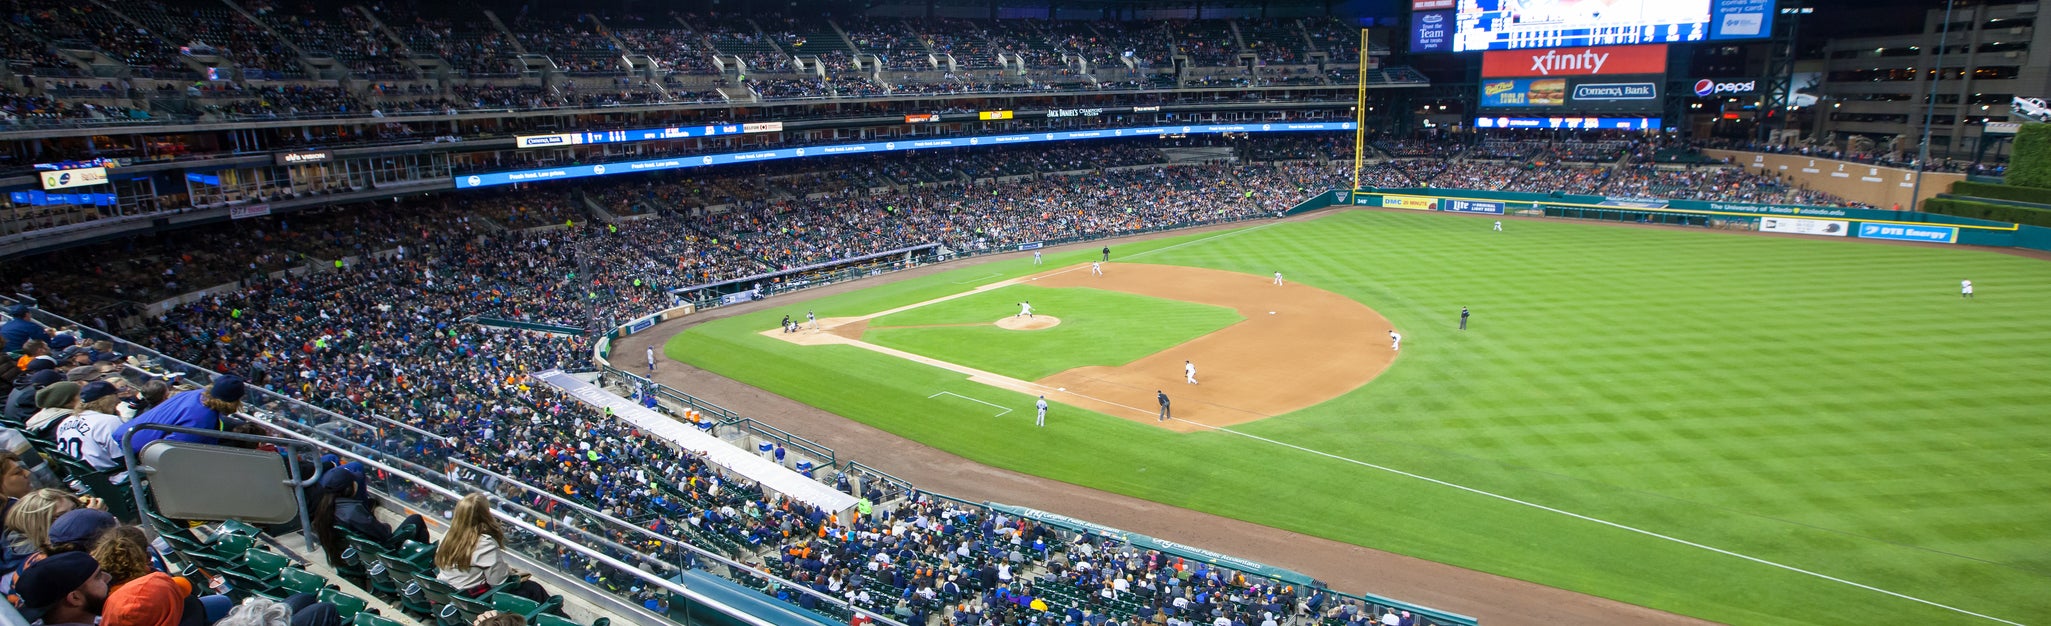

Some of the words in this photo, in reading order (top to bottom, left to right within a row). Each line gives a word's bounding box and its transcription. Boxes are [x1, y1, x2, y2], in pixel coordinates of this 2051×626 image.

[1420, 29, 1444, 38] Team
[1531, 49, 1610, 75] xfinity
[1625, 86, 1649, 95] Bank
[1714, 80, 1756, 94] pepsi
[1453, 200, 1469, 210] Lite
[1880, 227, 1903, 236] DTE
[1905, 228, 1947, 239] Energy
[1174, 543, 1200, 552] Certified
[1200, 549, 1220, 558] Public
[1221, 554, 1260, 569] Accountants
